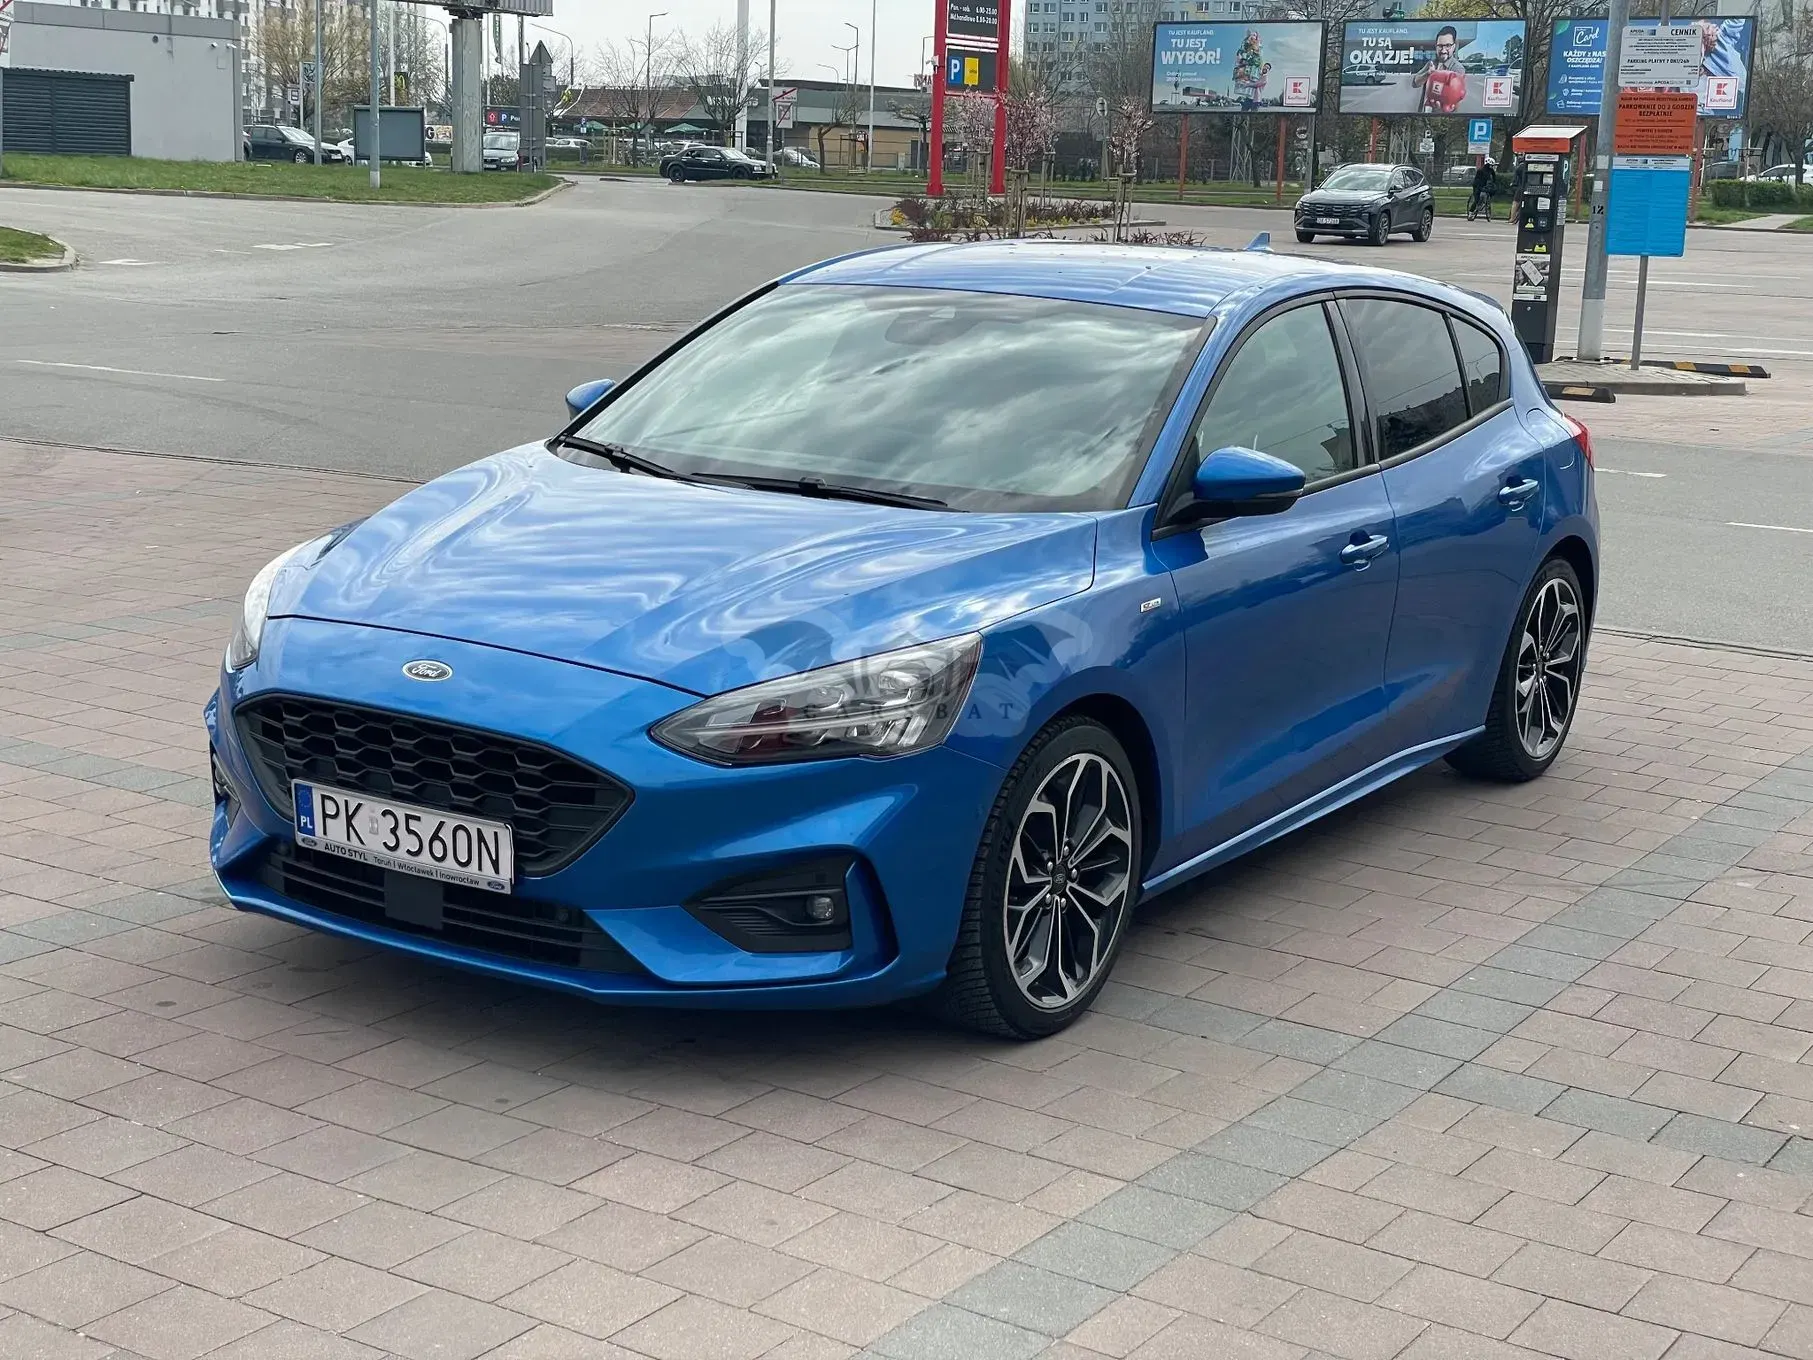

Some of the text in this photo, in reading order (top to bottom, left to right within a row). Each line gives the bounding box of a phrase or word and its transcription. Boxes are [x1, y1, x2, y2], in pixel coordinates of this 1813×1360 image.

[1670, 28, 1697, 36] CENNIK
[1170, 38, 1207, 48] TU JEST
[1362, 37, 1393, 50] TU SĄ
[1161, 47, 1221, 65] WYBÓR!
[1349, 46, 1415, 65] OKAZJE!
[950, 58, 960, 80] P
[1474, 122, 1487, 140] P
[1592, 205, 1604, 215] 12
[300, 815, 313, 829] PL
[320, 793, 500, 875] PK 3560N
[324, 842, 347, 857] AUTO
[347, 848, 368, 861] STYL
[374, 856, 392, 867] Toruń
